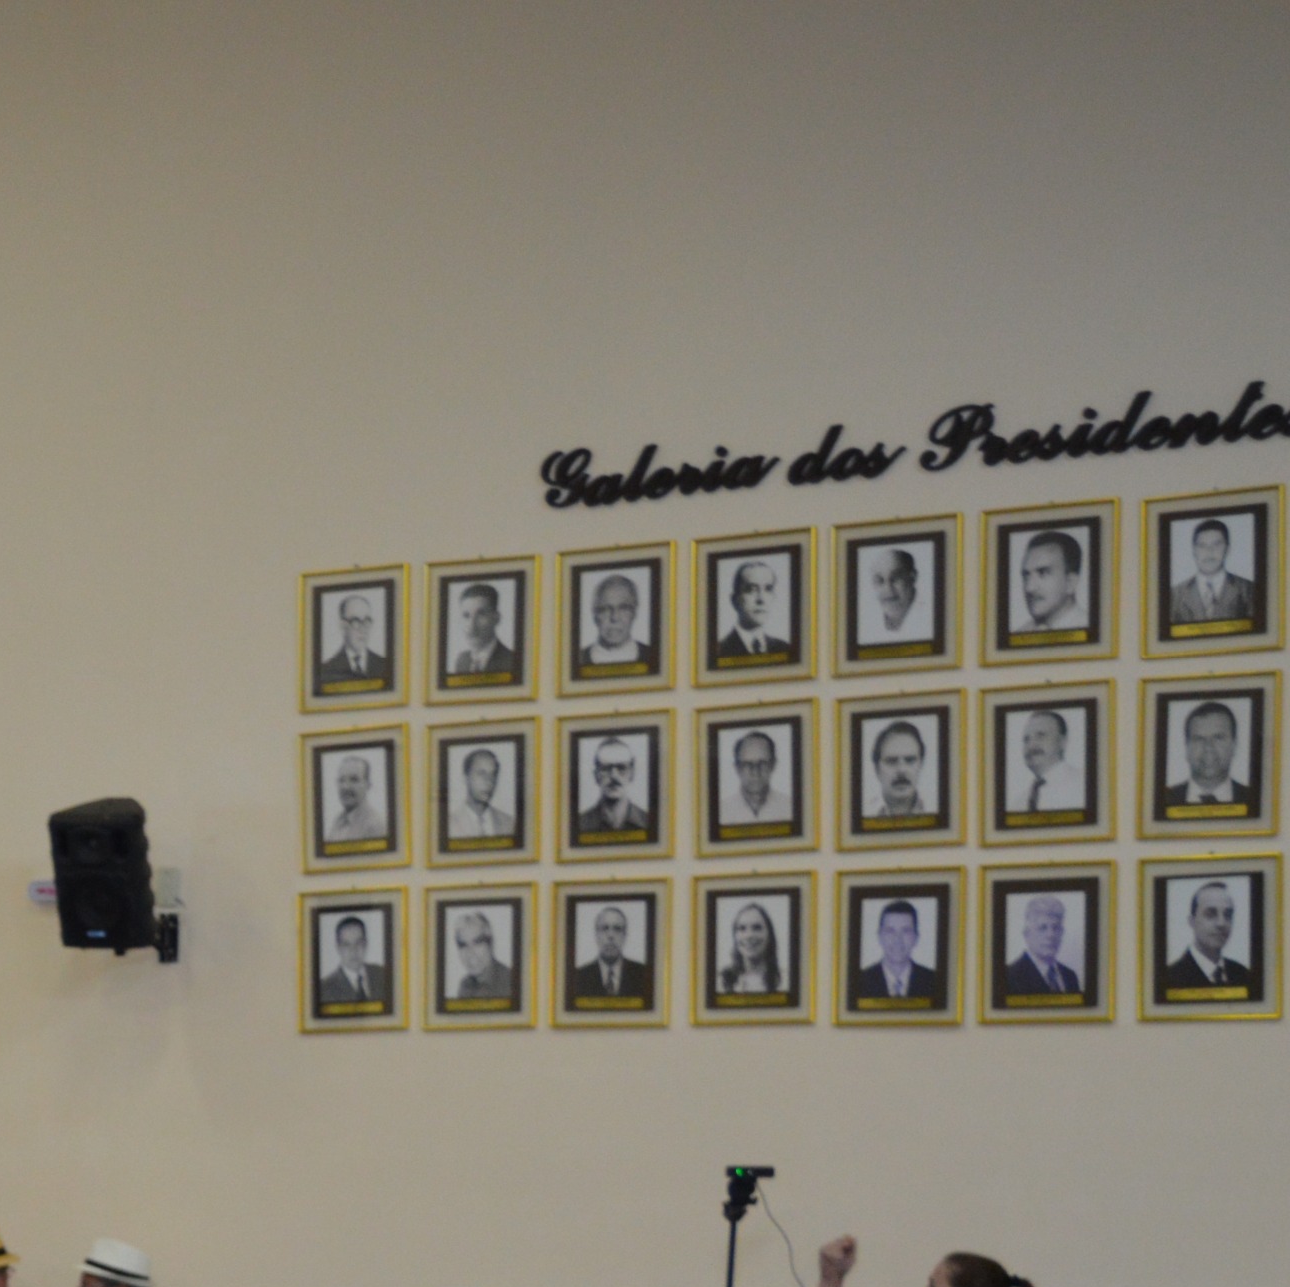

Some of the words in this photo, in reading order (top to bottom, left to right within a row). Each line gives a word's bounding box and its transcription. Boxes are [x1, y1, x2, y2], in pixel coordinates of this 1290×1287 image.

[541, 444, 780, 509] Galeria
[787, 424, 907, 486] dos
[920, 380, 1290, 472] Presidente
